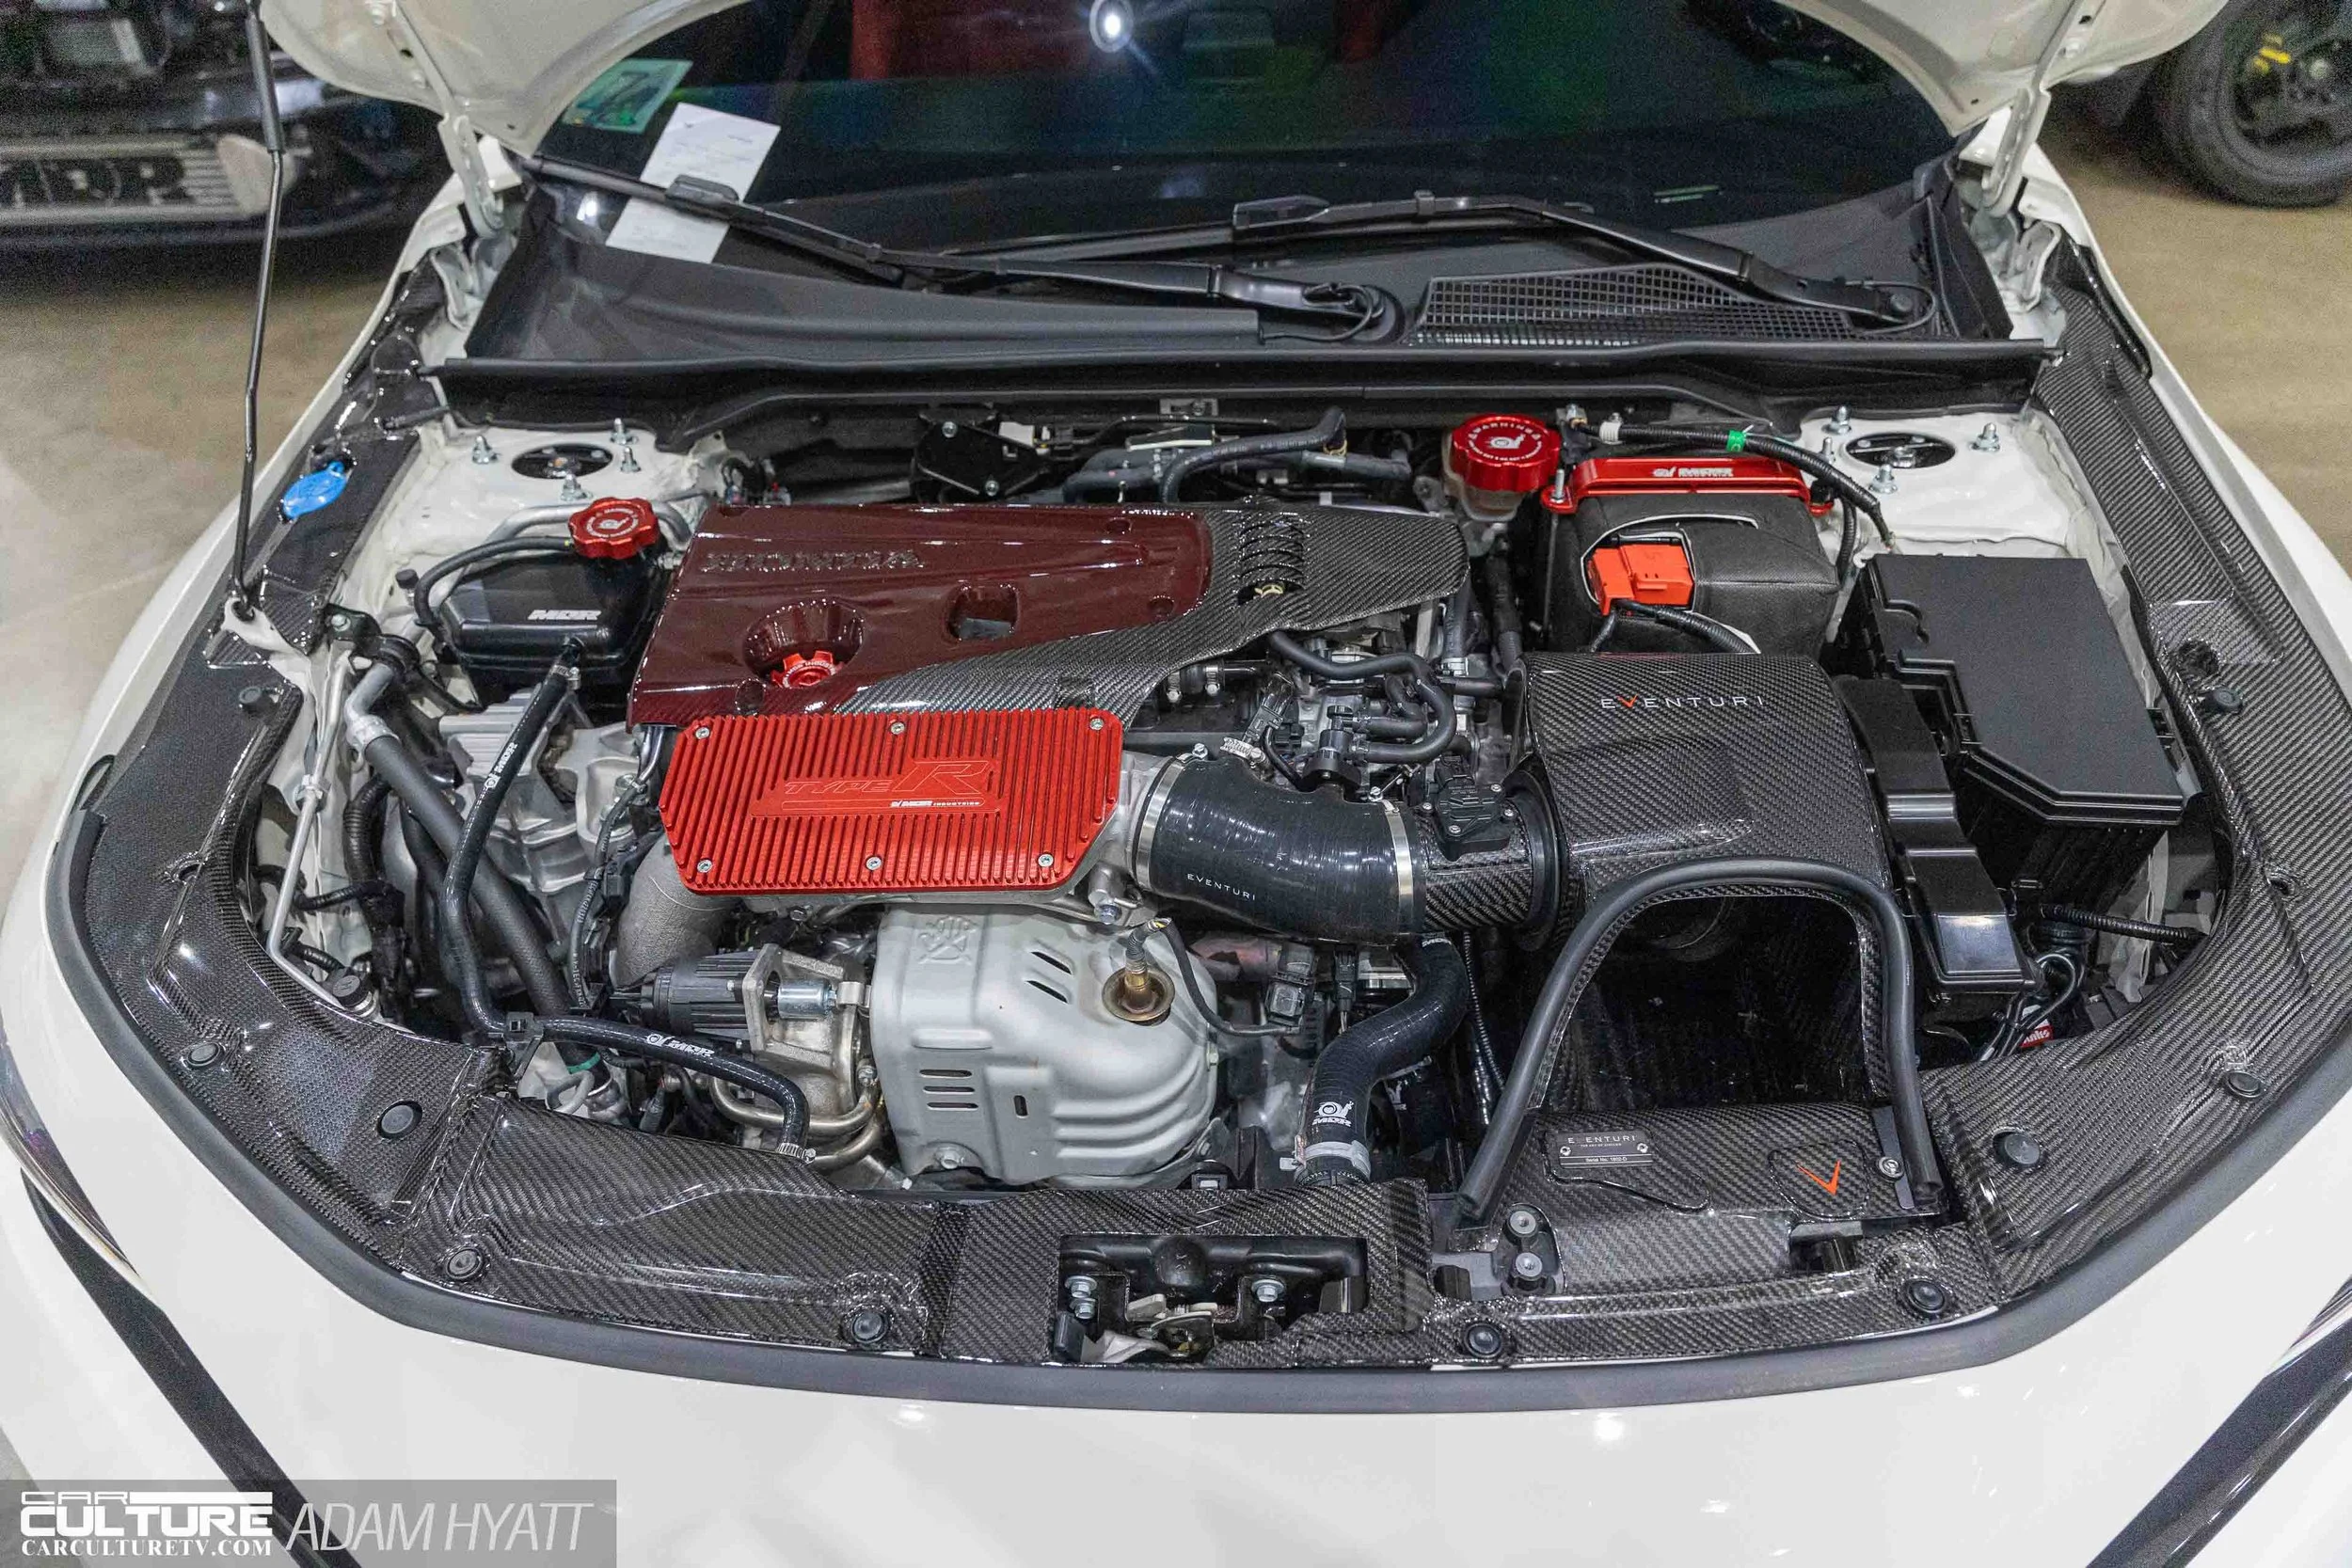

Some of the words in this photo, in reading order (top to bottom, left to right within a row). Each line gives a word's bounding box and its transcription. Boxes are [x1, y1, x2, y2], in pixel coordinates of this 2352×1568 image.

[1601, 693, 1763, 709] EVENTURI
[785, 780, 892, 795] TYPE
[893, 761, 989, 795] R
[1187, 873, 1255, 900] EVENTURI
